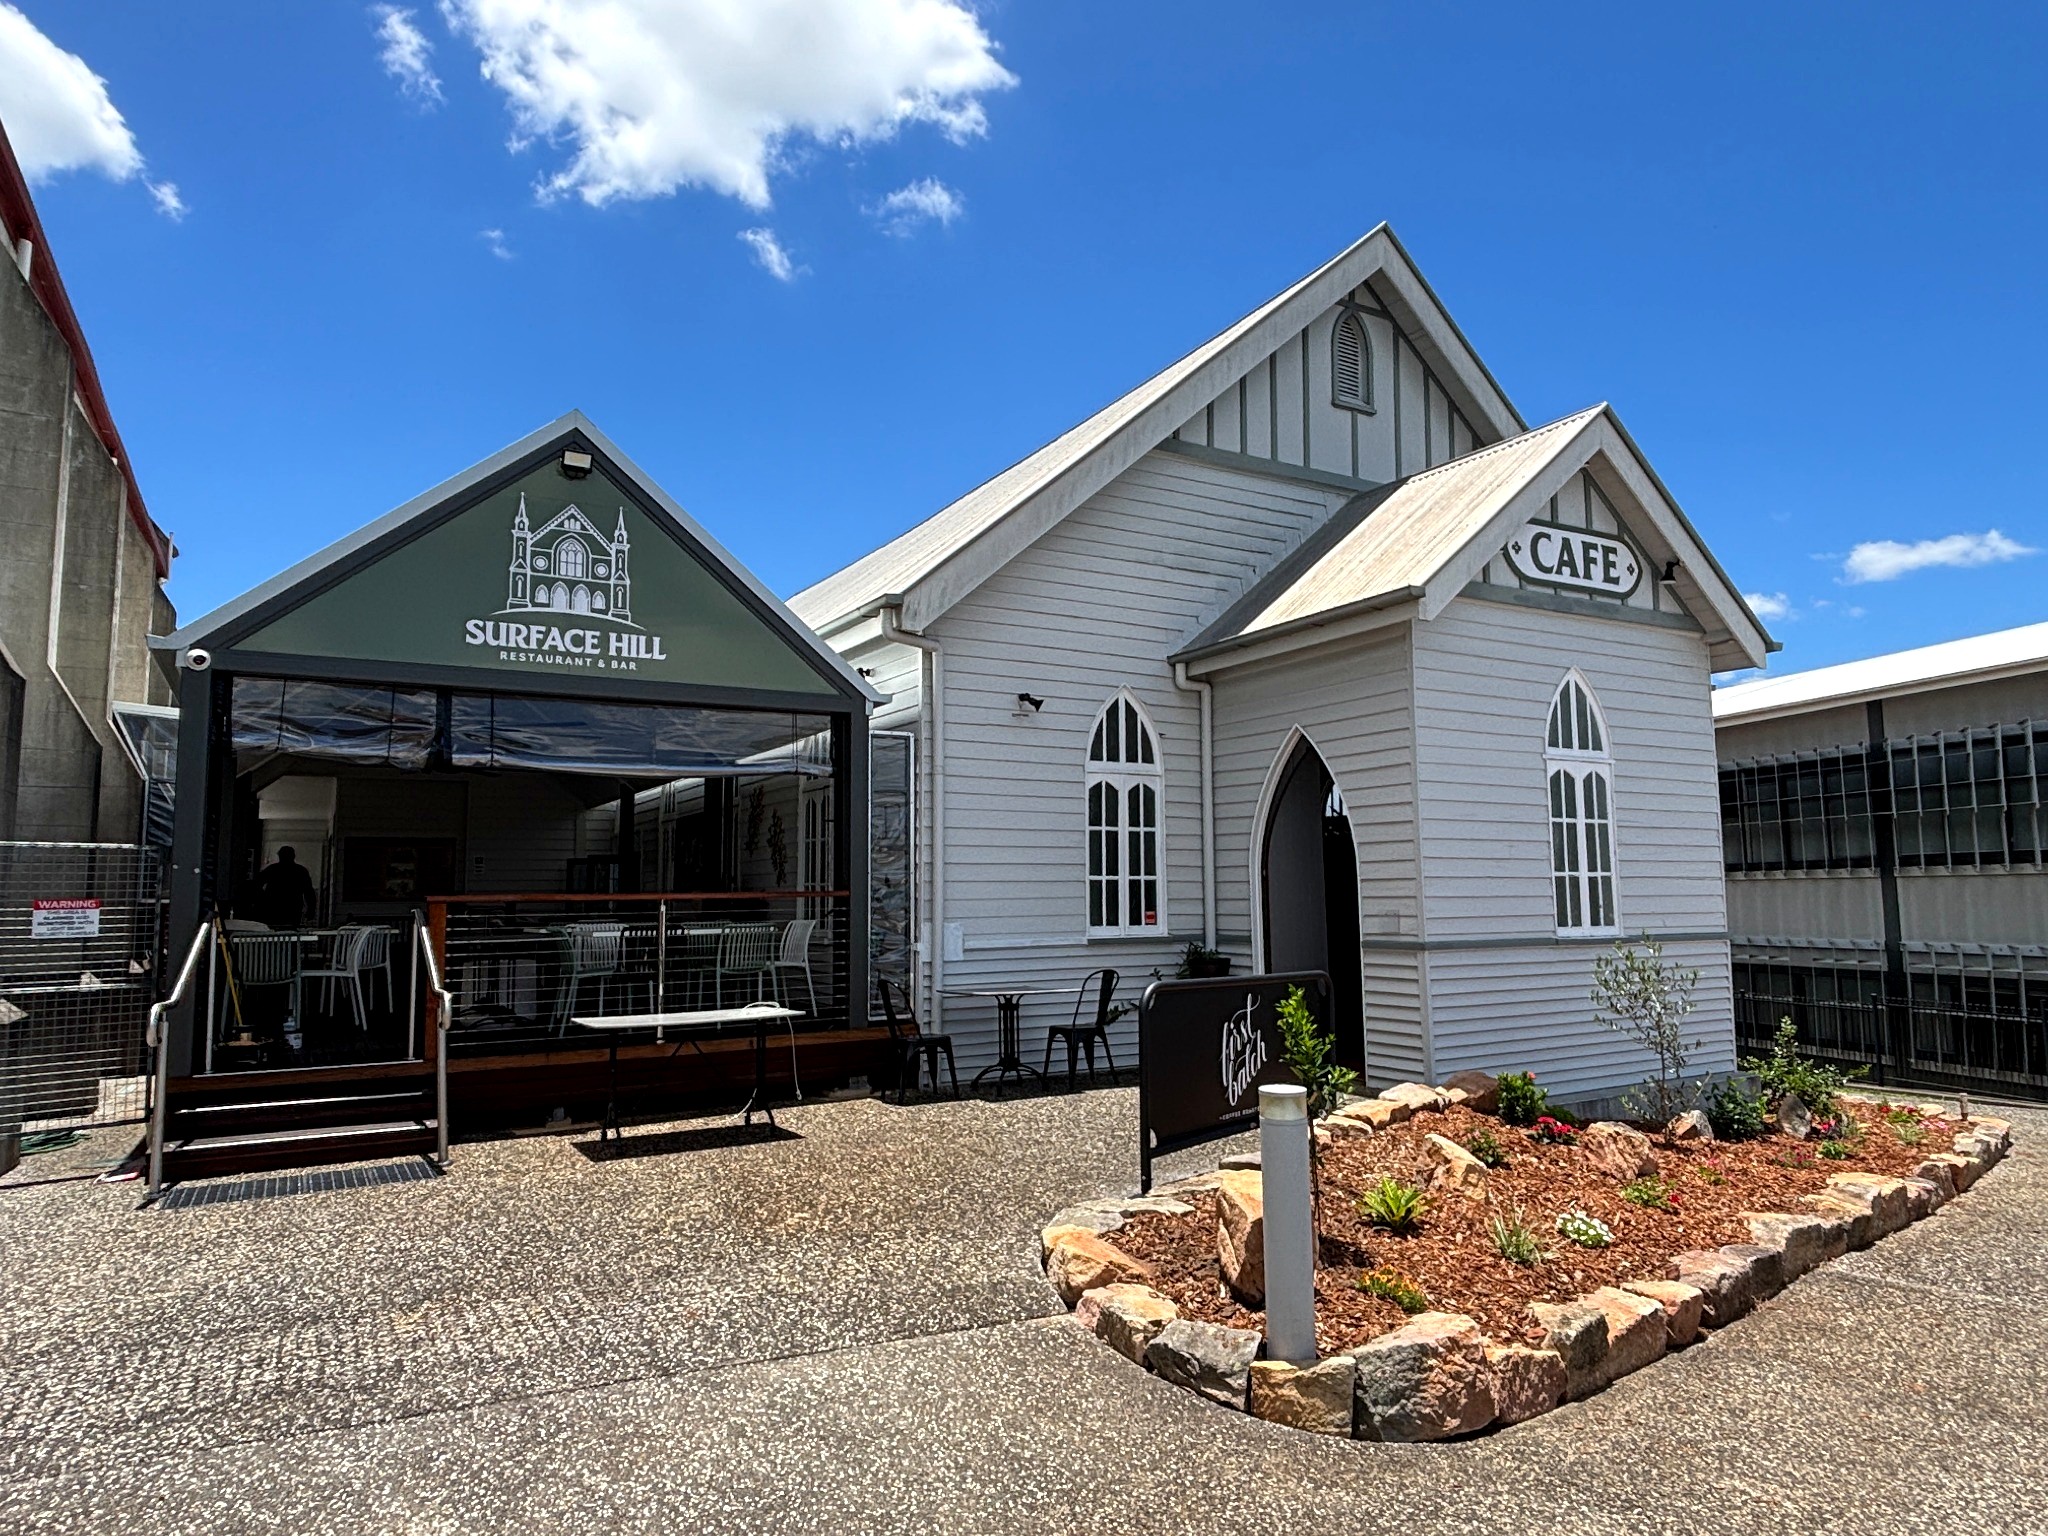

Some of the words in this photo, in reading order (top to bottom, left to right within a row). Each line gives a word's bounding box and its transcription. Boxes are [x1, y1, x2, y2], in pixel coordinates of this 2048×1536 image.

[1530, 531, 1620, 586] CAFE
[465, 619, 601, 655] SURFACE
[608, 632, 667, 660] HILL
[500, 651, 593, 667] RESTAURANT
[597, 659, 606, 668] &
[611, 660, 637, 671] BAR
[38, 900, 97, 909] WARNING
[1219, 993, 1261, 1087] first
[1225, 1029, 1267, 1106] batch
